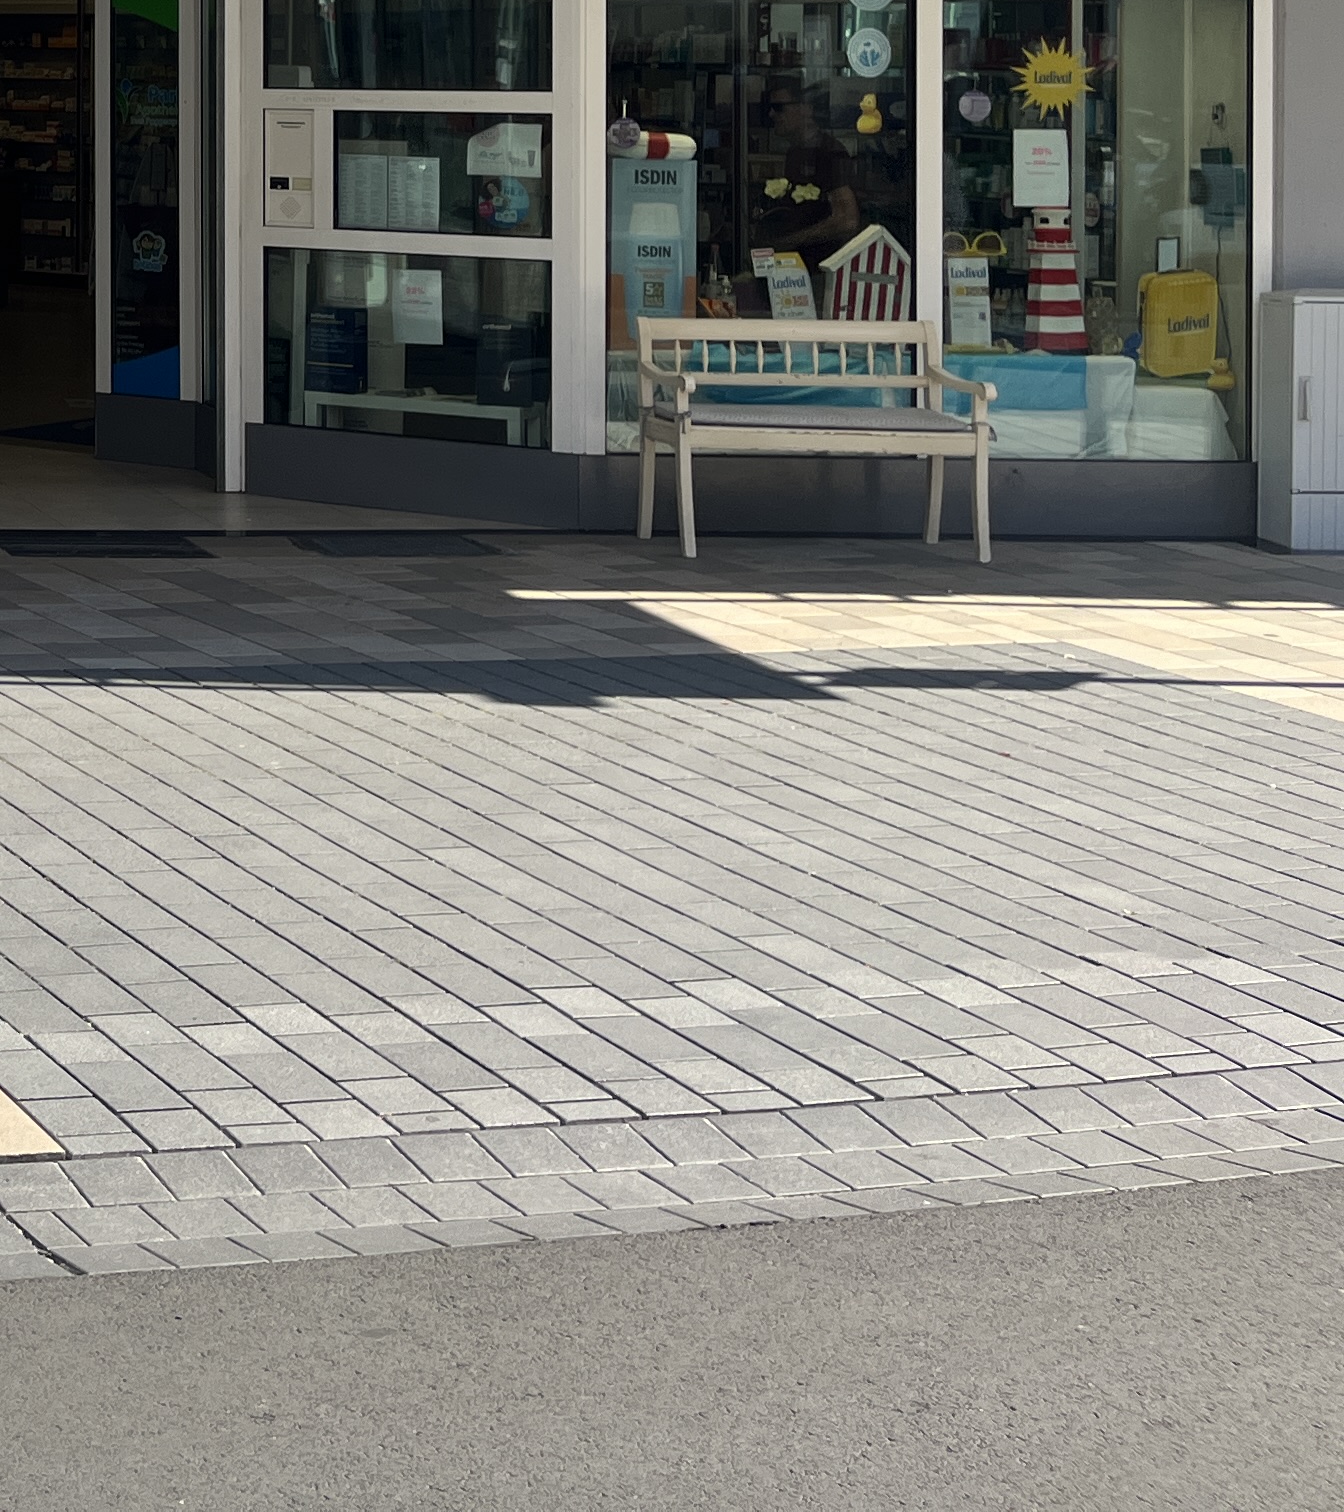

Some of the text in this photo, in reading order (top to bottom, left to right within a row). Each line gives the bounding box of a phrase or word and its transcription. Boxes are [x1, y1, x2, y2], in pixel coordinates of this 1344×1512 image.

[1034, 70, 1073, 85] Ladival
[634, 169, 677, 185] ISDIN
[637, 245, 671, 258] ISDIN
[952, 267, 987, 279] Ladival
[772, 275, 807, 290] Ladival
[1167, 314, 1210, 334] Ladival
